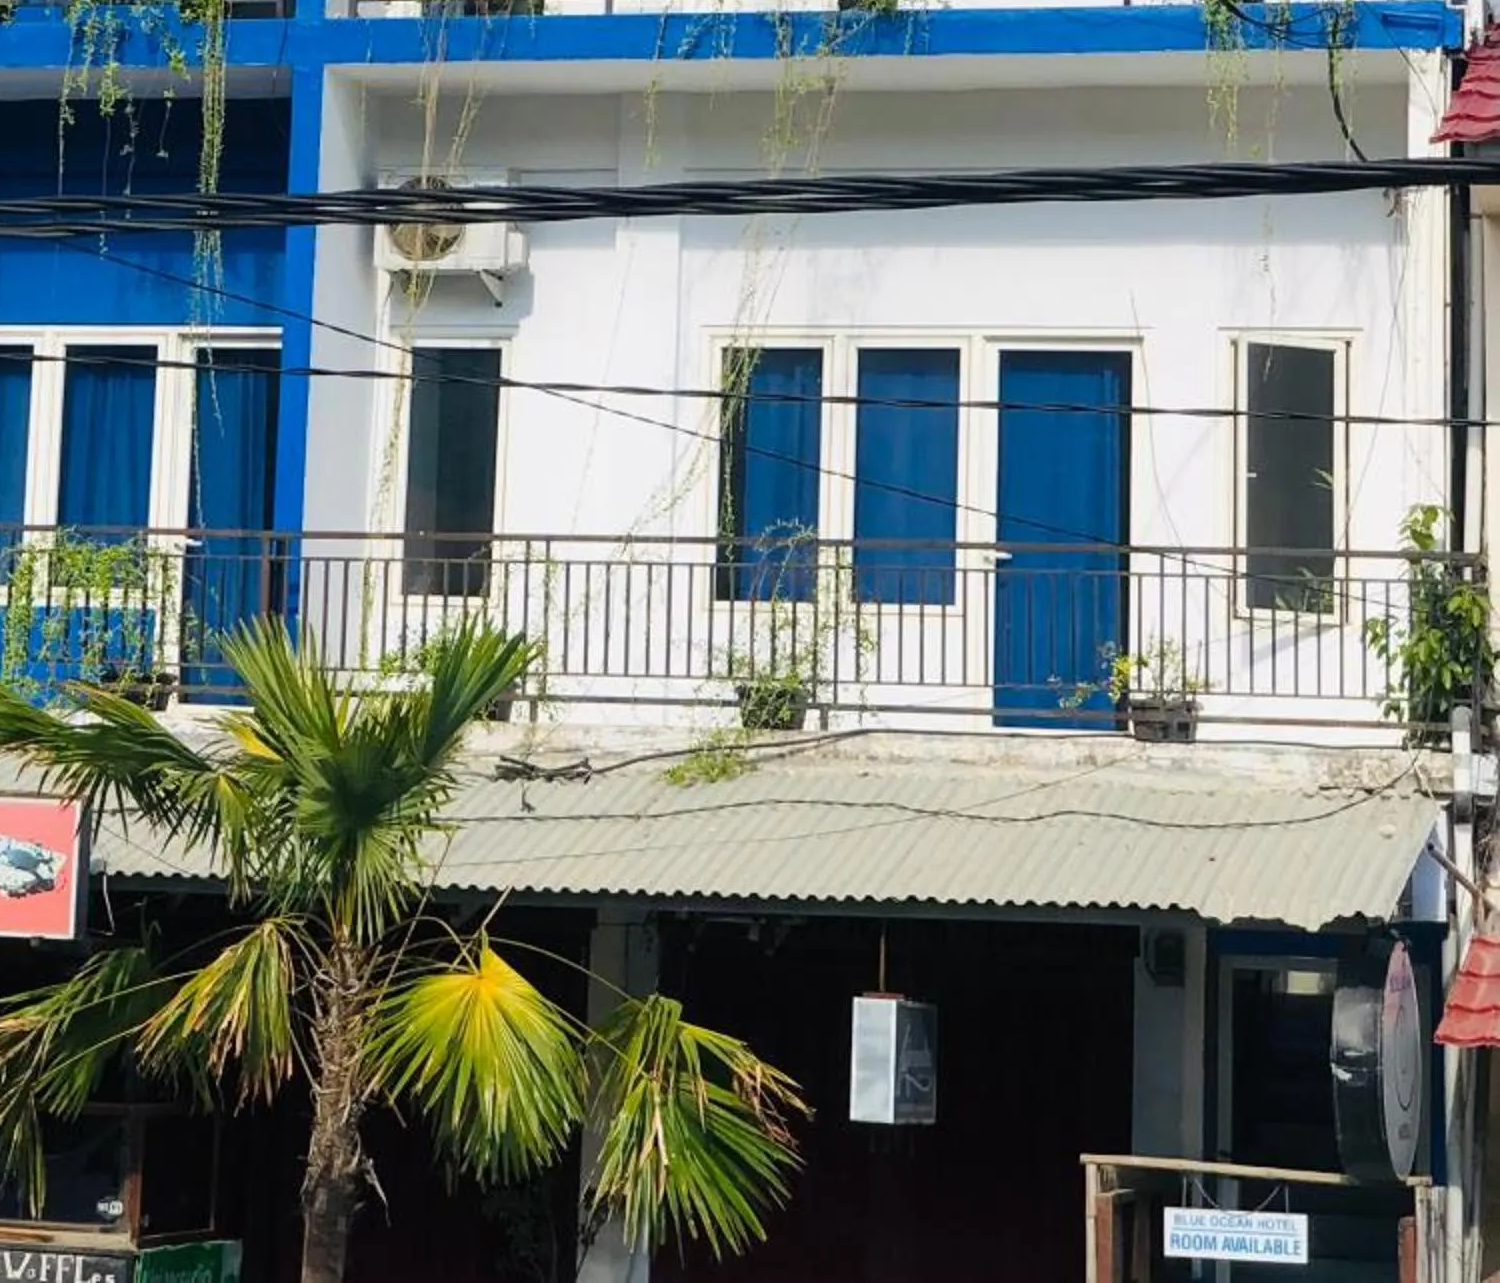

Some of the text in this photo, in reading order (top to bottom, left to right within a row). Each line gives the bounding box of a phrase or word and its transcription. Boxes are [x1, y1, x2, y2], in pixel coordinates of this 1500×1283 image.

[1173, 1214, 1298, 1231] BLUE OCEAN HOTEL
[1170, 1232, 1302, 1256] ROOM AVAILABLE
